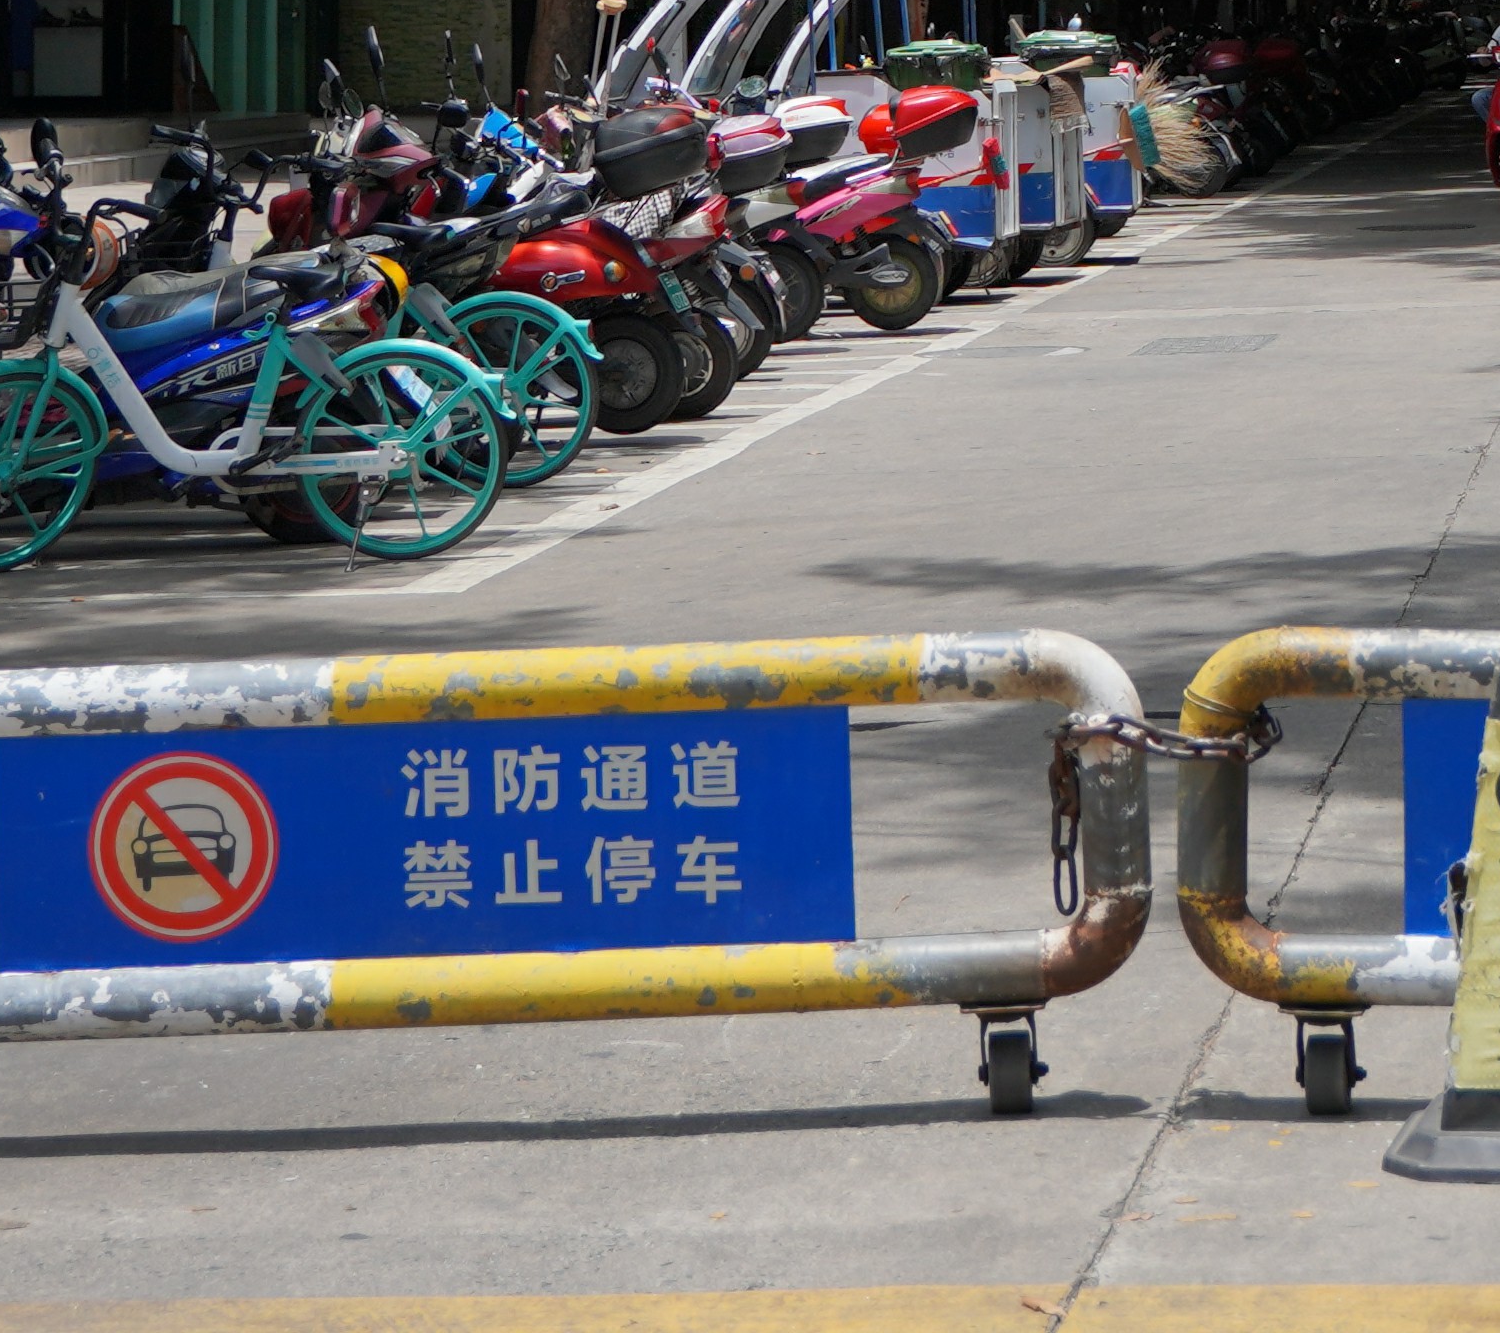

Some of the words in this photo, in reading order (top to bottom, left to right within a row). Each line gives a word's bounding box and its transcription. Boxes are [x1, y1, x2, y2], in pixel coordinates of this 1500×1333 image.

[216, 352, 257, 381] 新日
[400, 740, 741, 818] 消防通道
[403, 835, 743, 909] 禁止停车
